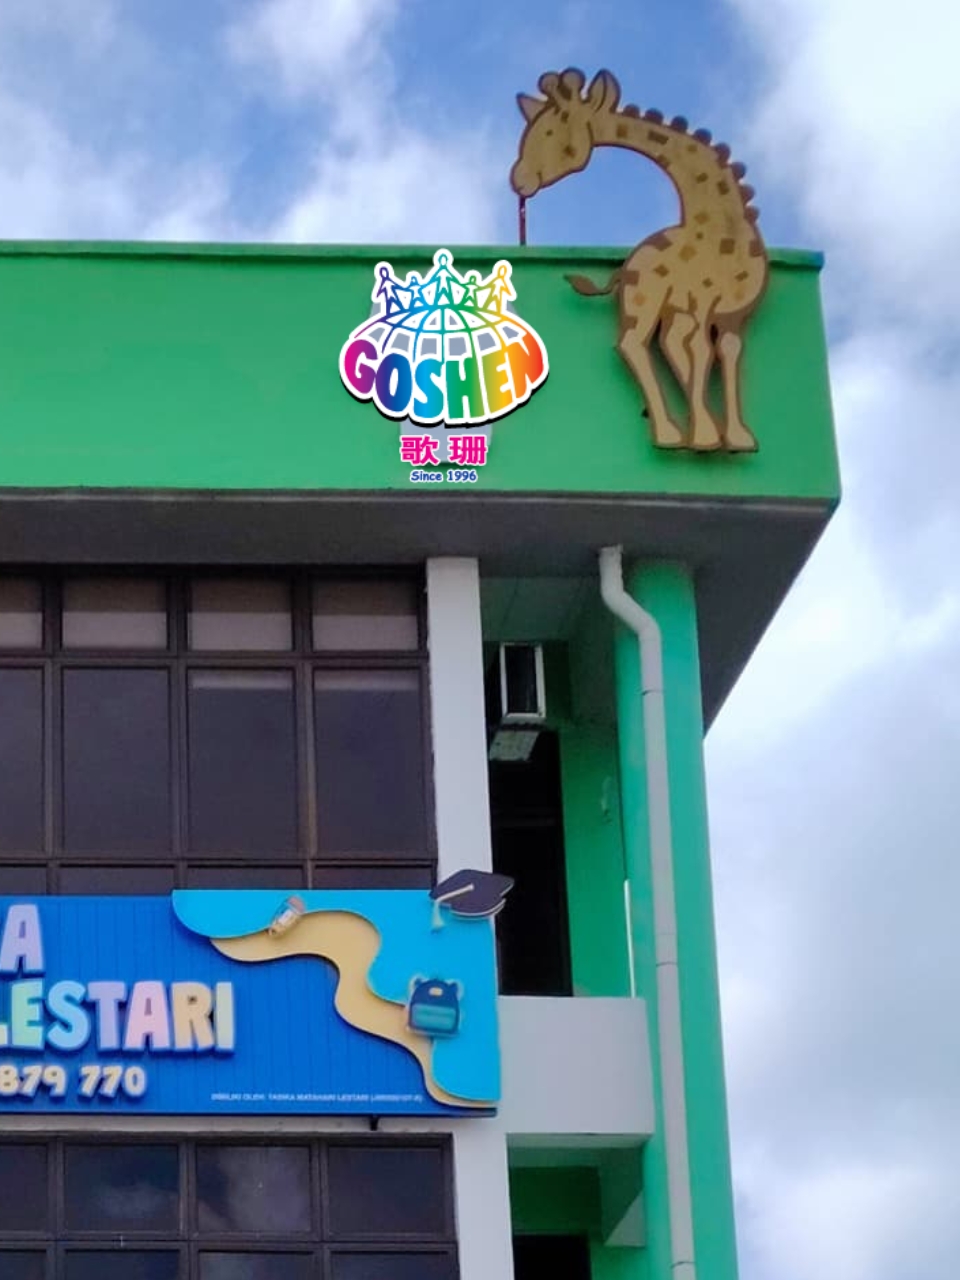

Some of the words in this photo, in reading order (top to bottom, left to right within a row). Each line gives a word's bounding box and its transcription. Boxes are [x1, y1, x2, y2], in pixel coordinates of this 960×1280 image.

[343, 330, 545, 419] GOSHEN
[400, 436, 488, 466] 歌珊
[411, 470, 442, 482] Since
[447, 470, 478, 482] 1996
[78, 1063, 147, 1096] 770
